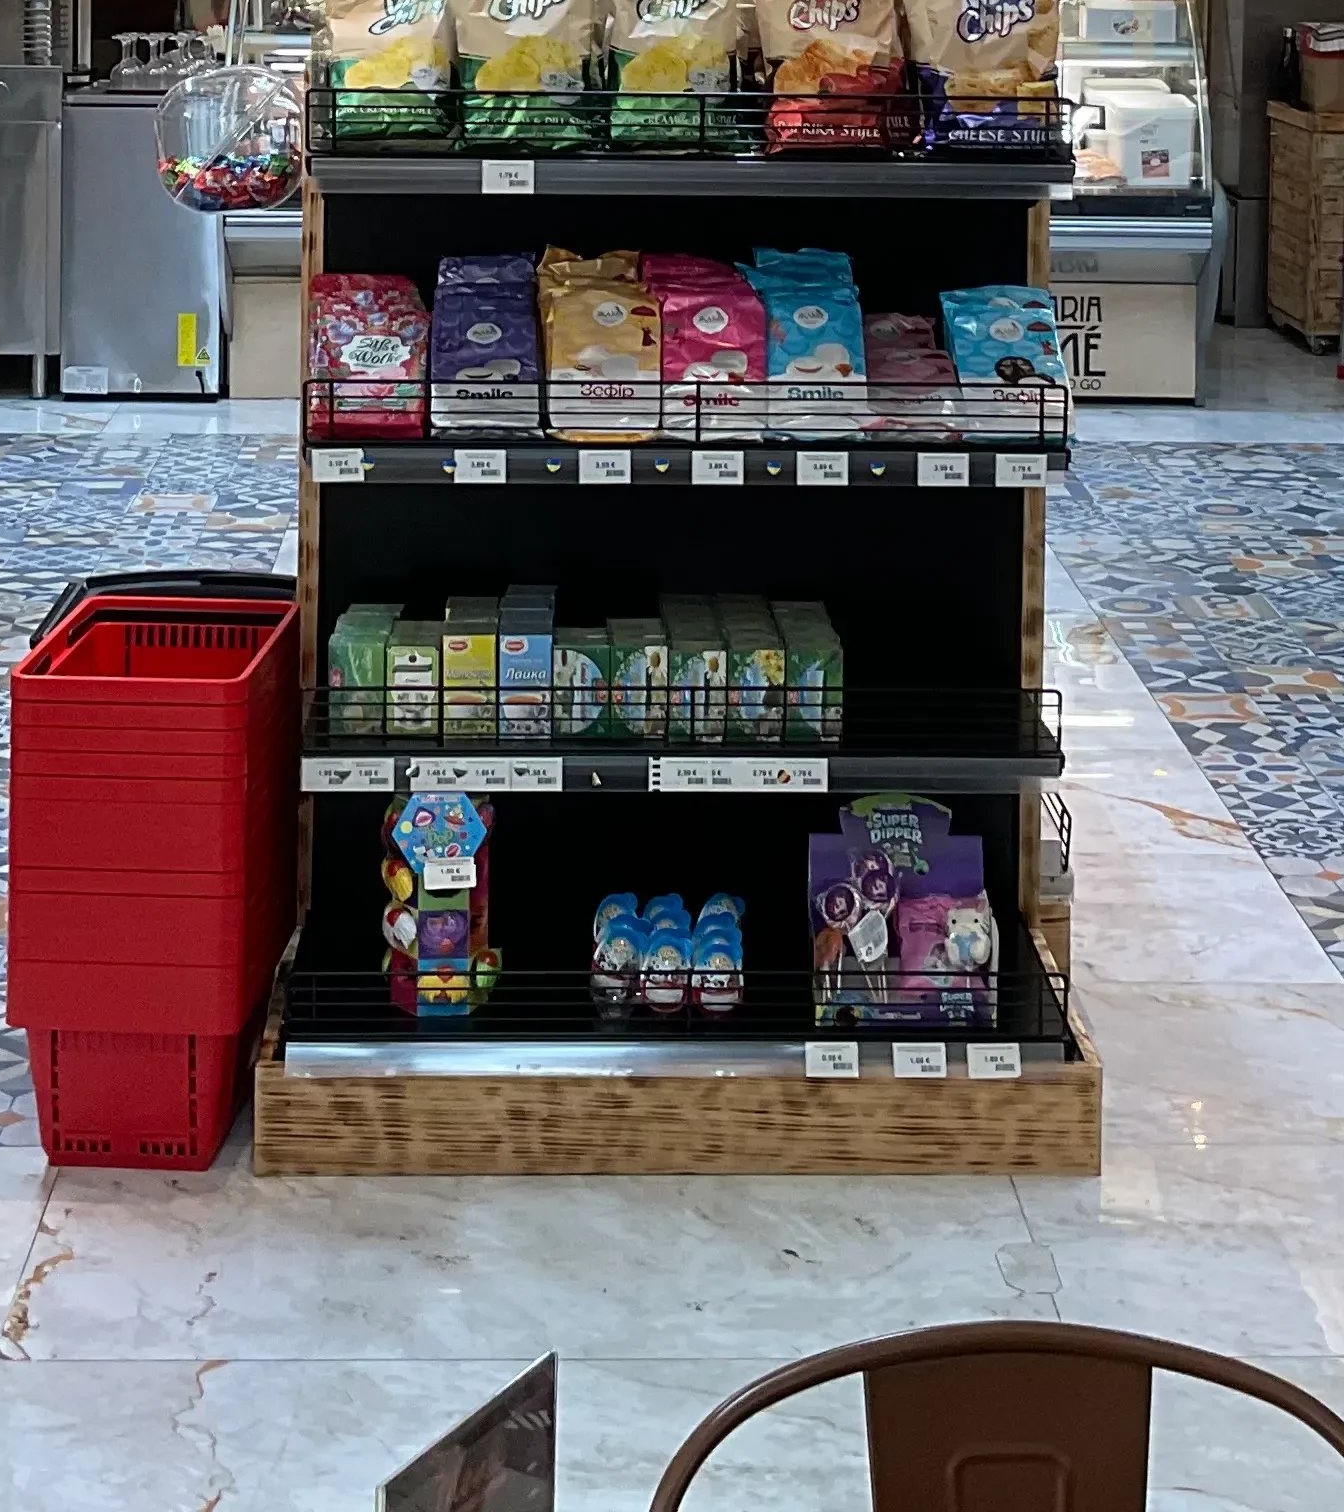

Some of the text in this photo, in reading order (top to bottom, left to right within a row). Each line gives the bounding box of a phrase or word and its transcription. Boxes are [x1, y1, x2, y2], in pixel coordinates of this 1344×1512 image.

[1080, 378, 1102, 390] GO
[872, 812, 920, 829] SUPER
[869, 827, 923, 845] DIPPER
